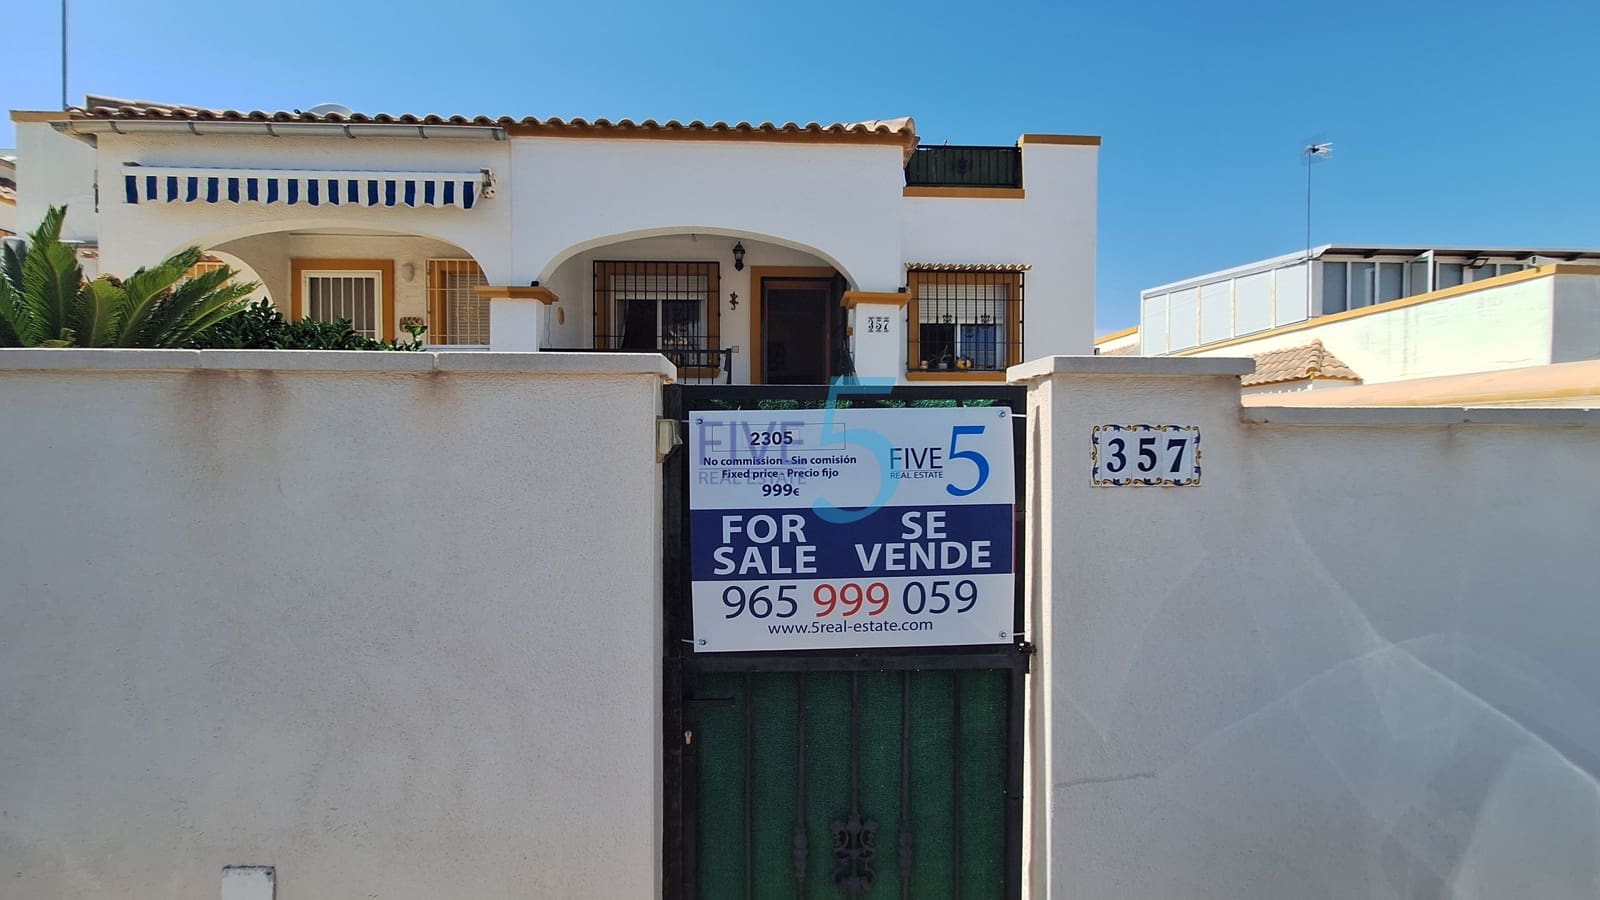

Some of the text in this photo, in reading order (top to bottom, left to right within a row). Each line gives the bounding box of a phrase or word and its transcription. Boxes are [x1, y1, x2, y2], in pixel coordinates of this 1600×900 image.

[868, 316, 890, 333] 357
[750, 431, 793, 446] 2305
[703, 457, 718, 466] No
[720, 456, 783, 466] commission
[791, 456, 807, 465] Sin
[810, 454, 857, 465] comisión
[890, 425, 990, 496] FIVE 5
[1106, 437, 1188, 473] 357
[722, 469, 750, 479] Fixed
[753, 469, 779, 480] price
[787, 468, 819, 478] Precio
[822, 467, 839, 479] fijo
[890, 471, 944, 479] REAL ESTATE
[762, 483, 800, 497] 999€
[721, 514, 807, 544] FOR
[901, 510, 947, 540] SE
[713, 545, 817, 576] SALE
[855, 540, 992, 572] VENDE
[722, 580, 978, 619] 965 999 059
[768, 619, 933, 635] www.5real-estate.com
